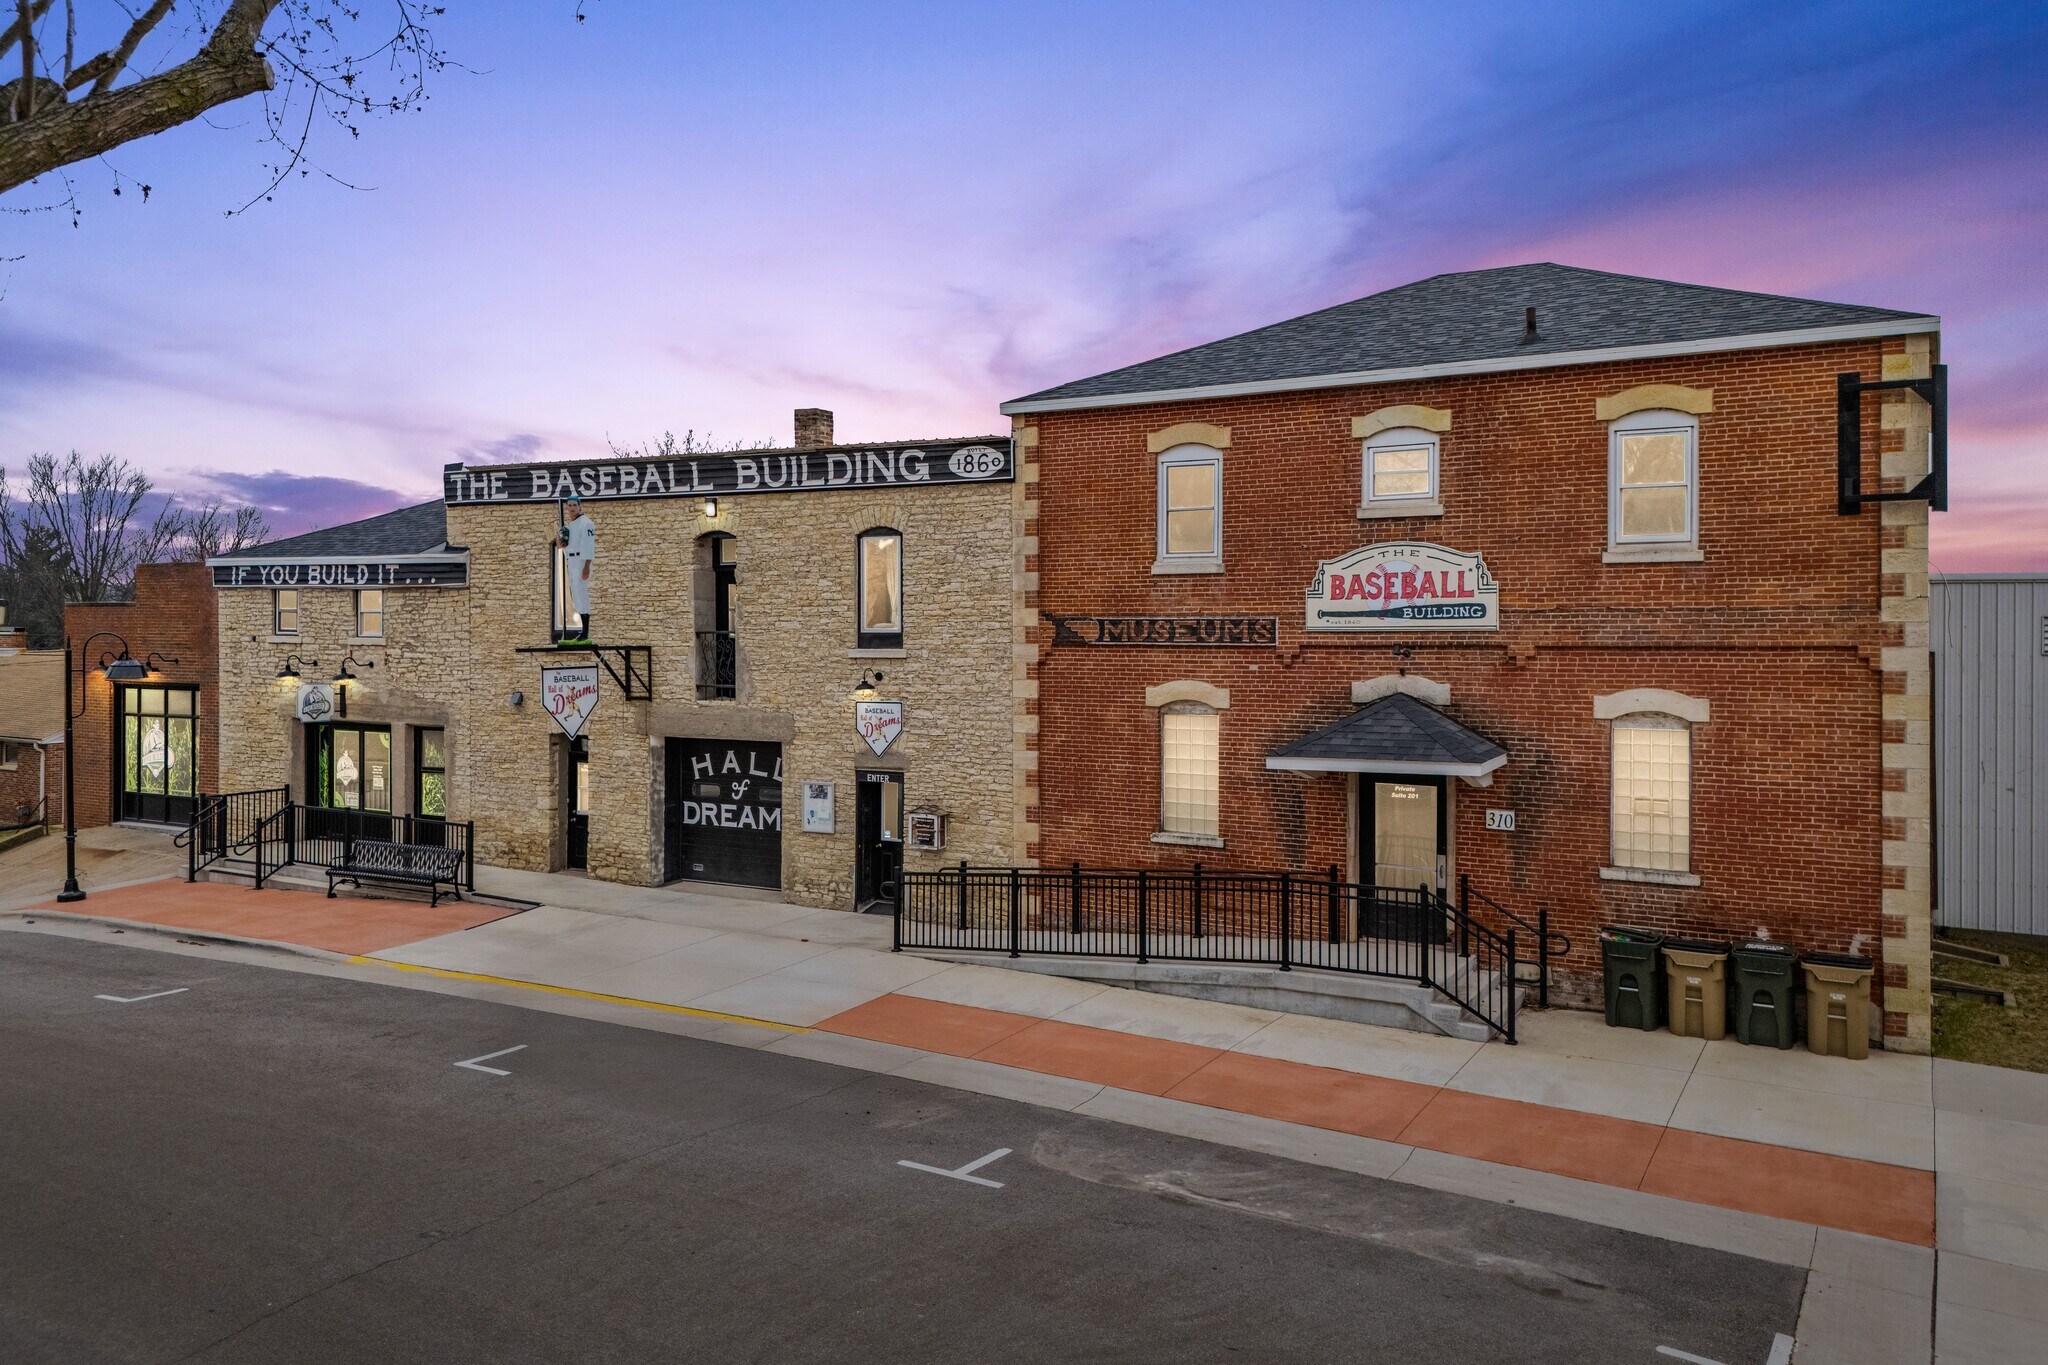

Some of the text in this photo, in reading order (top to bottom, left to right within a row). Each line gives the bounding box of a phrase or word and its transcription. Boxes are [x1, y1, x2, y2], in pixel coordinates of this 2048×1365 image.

[956, 453, 1001, 474] 1860
[450, 449, 931, 502] THE BASEBALL BUILDING
[1377, 549, 1421, 558] THE
[231, 566, 251, 585] IF
[259, 565, 300, 585] YOU
[307, 565, 369, 585] BUILD
[1329, 570, 1475, 601] BASEBALL
[1402, 605, 1483, 619] BUILDING
[1102, 619, 1272, 643] MUSEUMS
[553, 674, 590, 684] BASEBALL
[551, 684, 597, 716] Dreams
[864, 707, 895, 715] BASEBALL
[862, 717, 901, 738] Dreams
[691, 750, 782, 783] HALL
[866, 773, 890, 783] ENTER
[731, 778, 751, 800] of
[1394, 785, 1416, 793] Private
[683, 801, 782, 832] DREAM
[1487, 811, 1514, 829] 310
